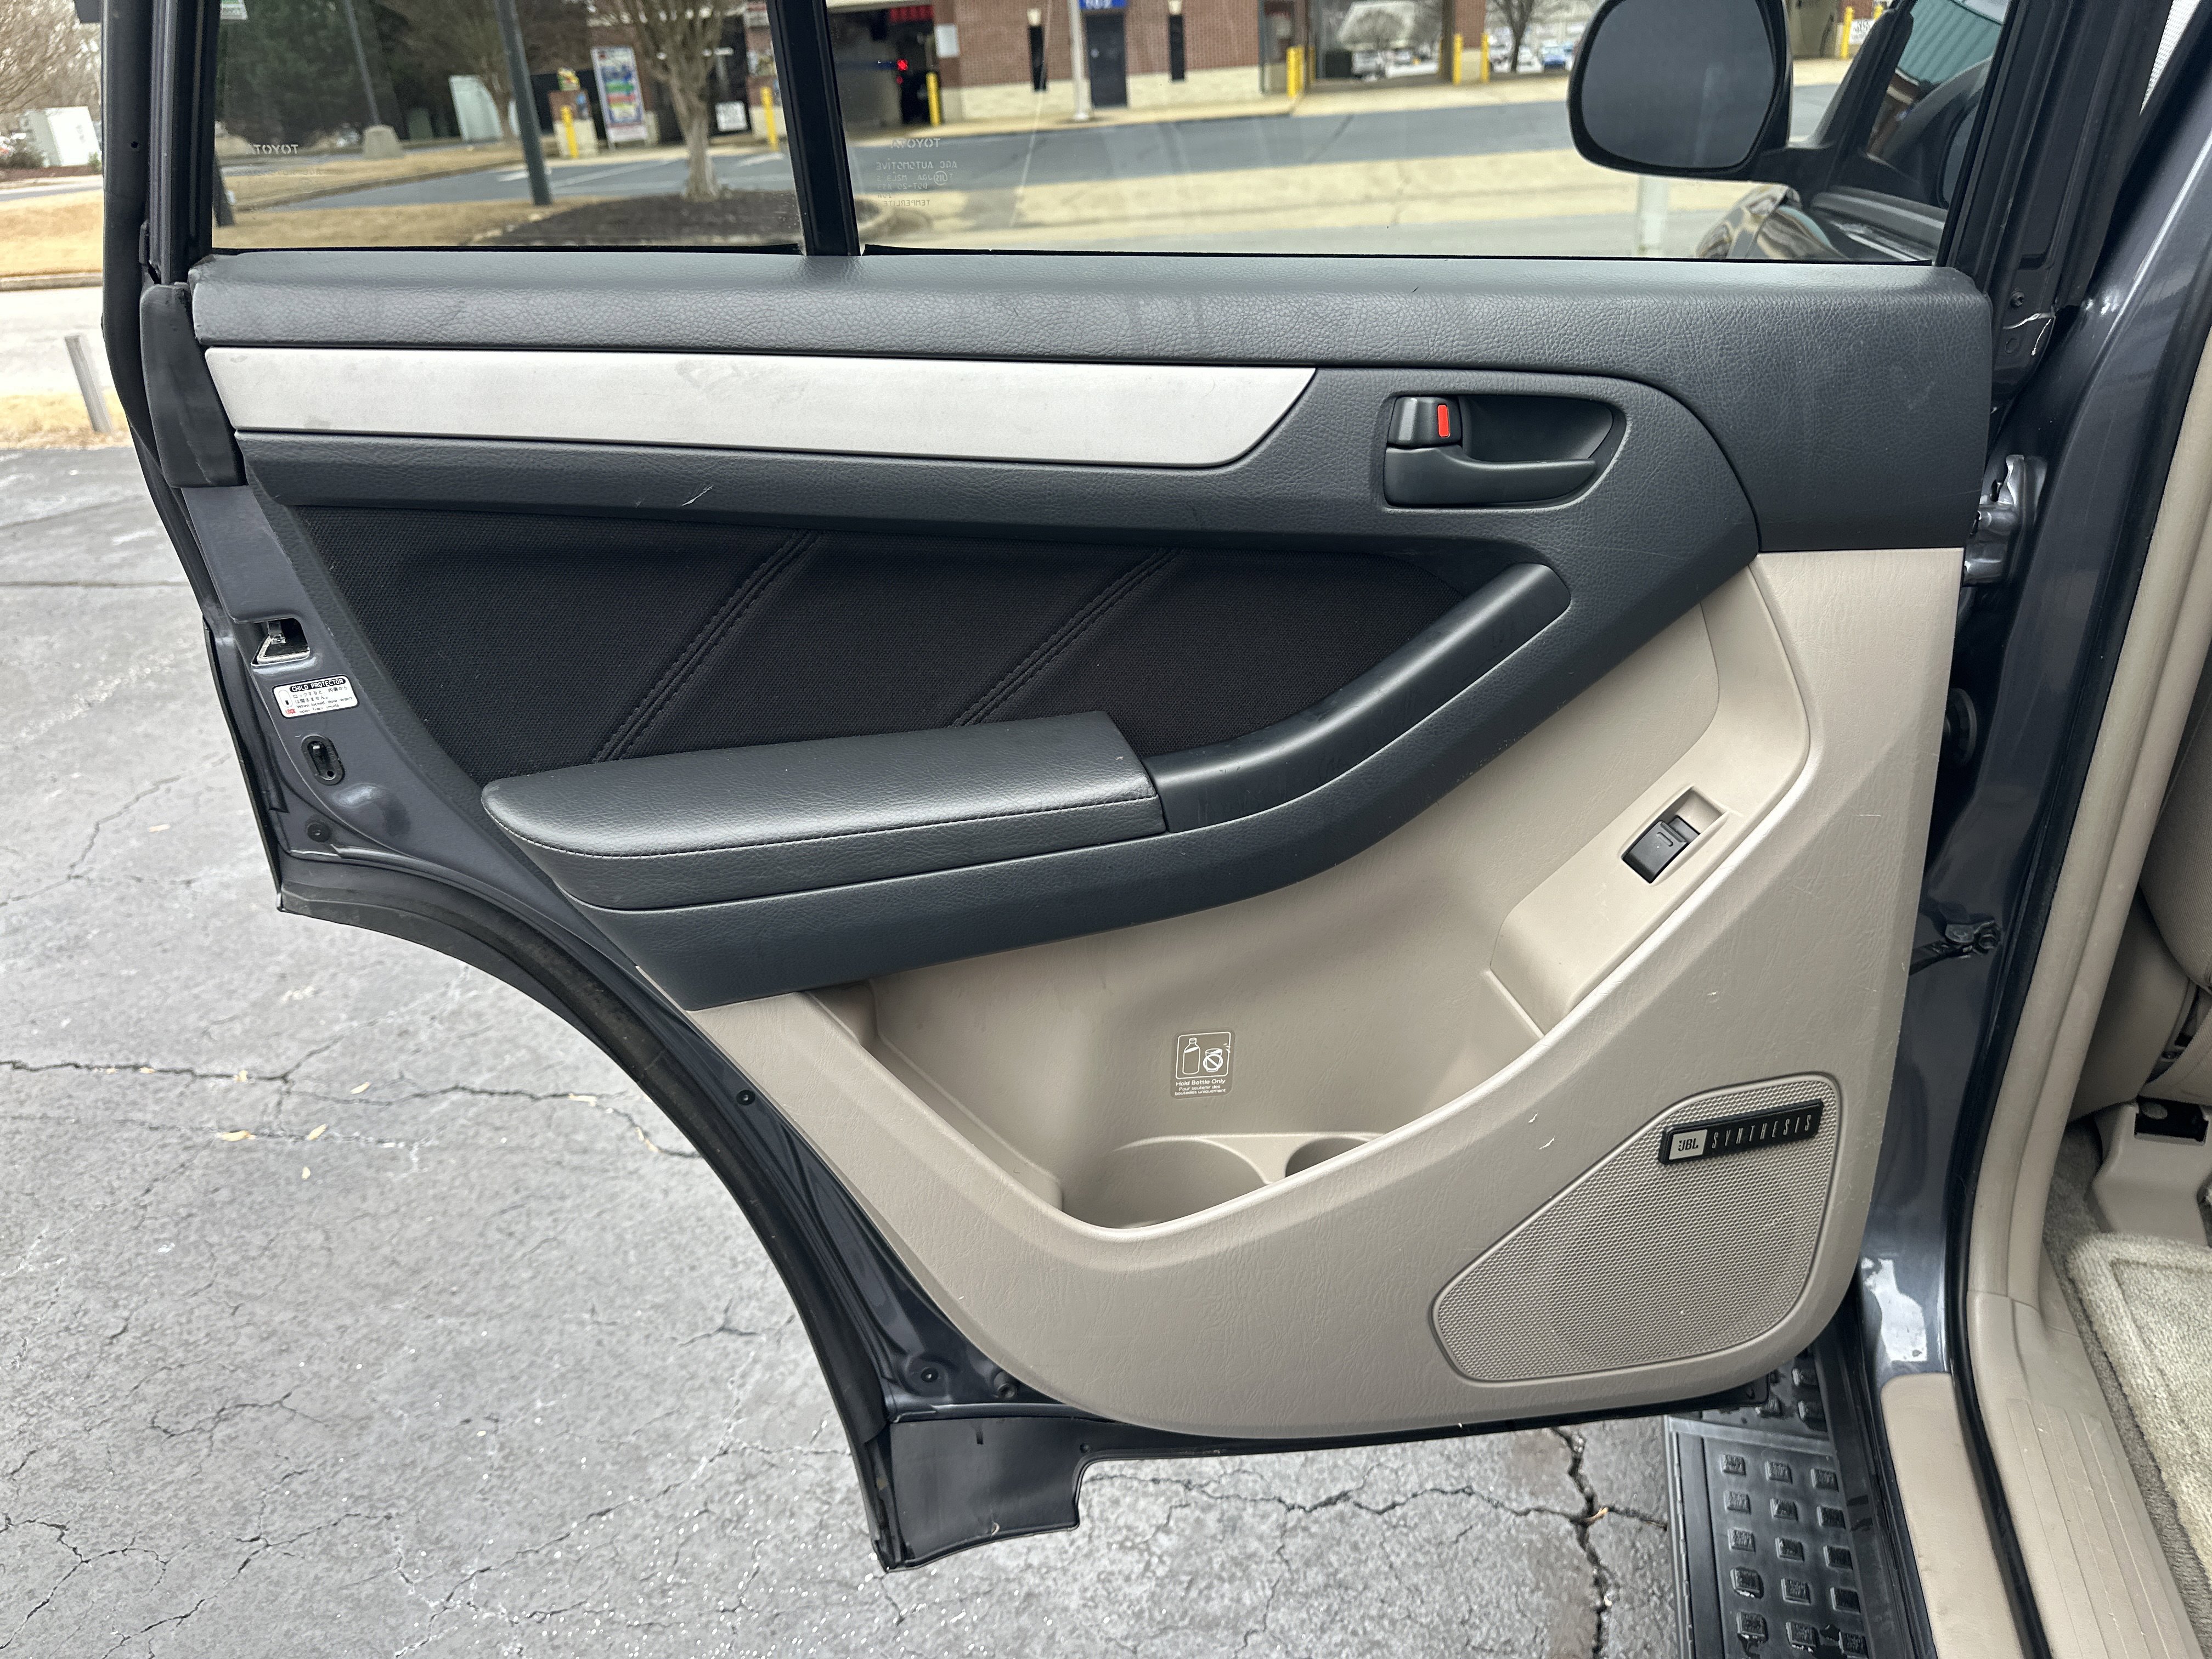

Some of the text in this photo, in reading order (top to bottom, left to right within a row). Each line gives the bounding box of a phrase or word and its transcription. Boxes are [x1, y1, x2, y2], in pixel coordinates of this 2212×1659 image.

[311, 679, 344, 689] PROTECTOR
[1678, 1114, 1812, 1152] JBL SYNTHESIS
